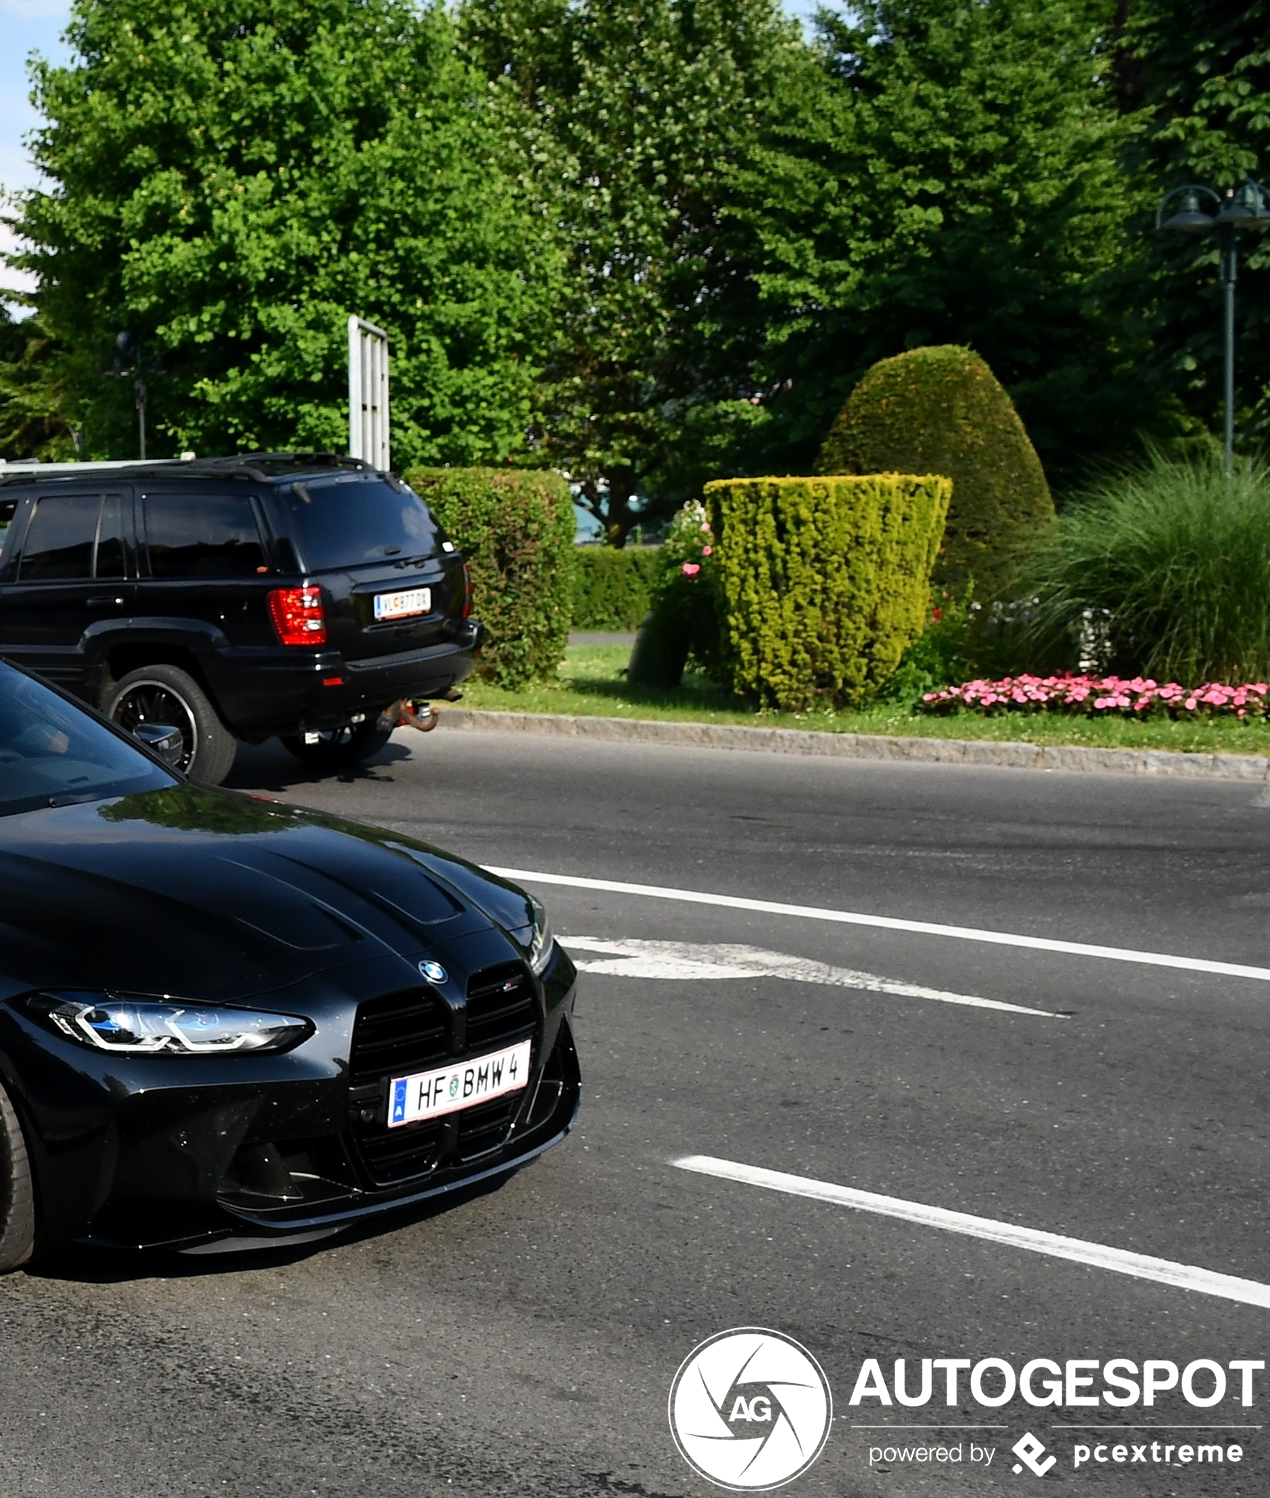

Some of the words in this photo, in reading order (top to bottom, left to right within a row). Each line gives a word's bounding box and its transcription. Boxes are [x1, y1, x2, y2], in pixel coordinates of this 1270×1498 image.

[418, 1077, 446, 1111] HF
[463, 1059, 505, 1098] BMW
[509, 1054, 518, 1080] 4
